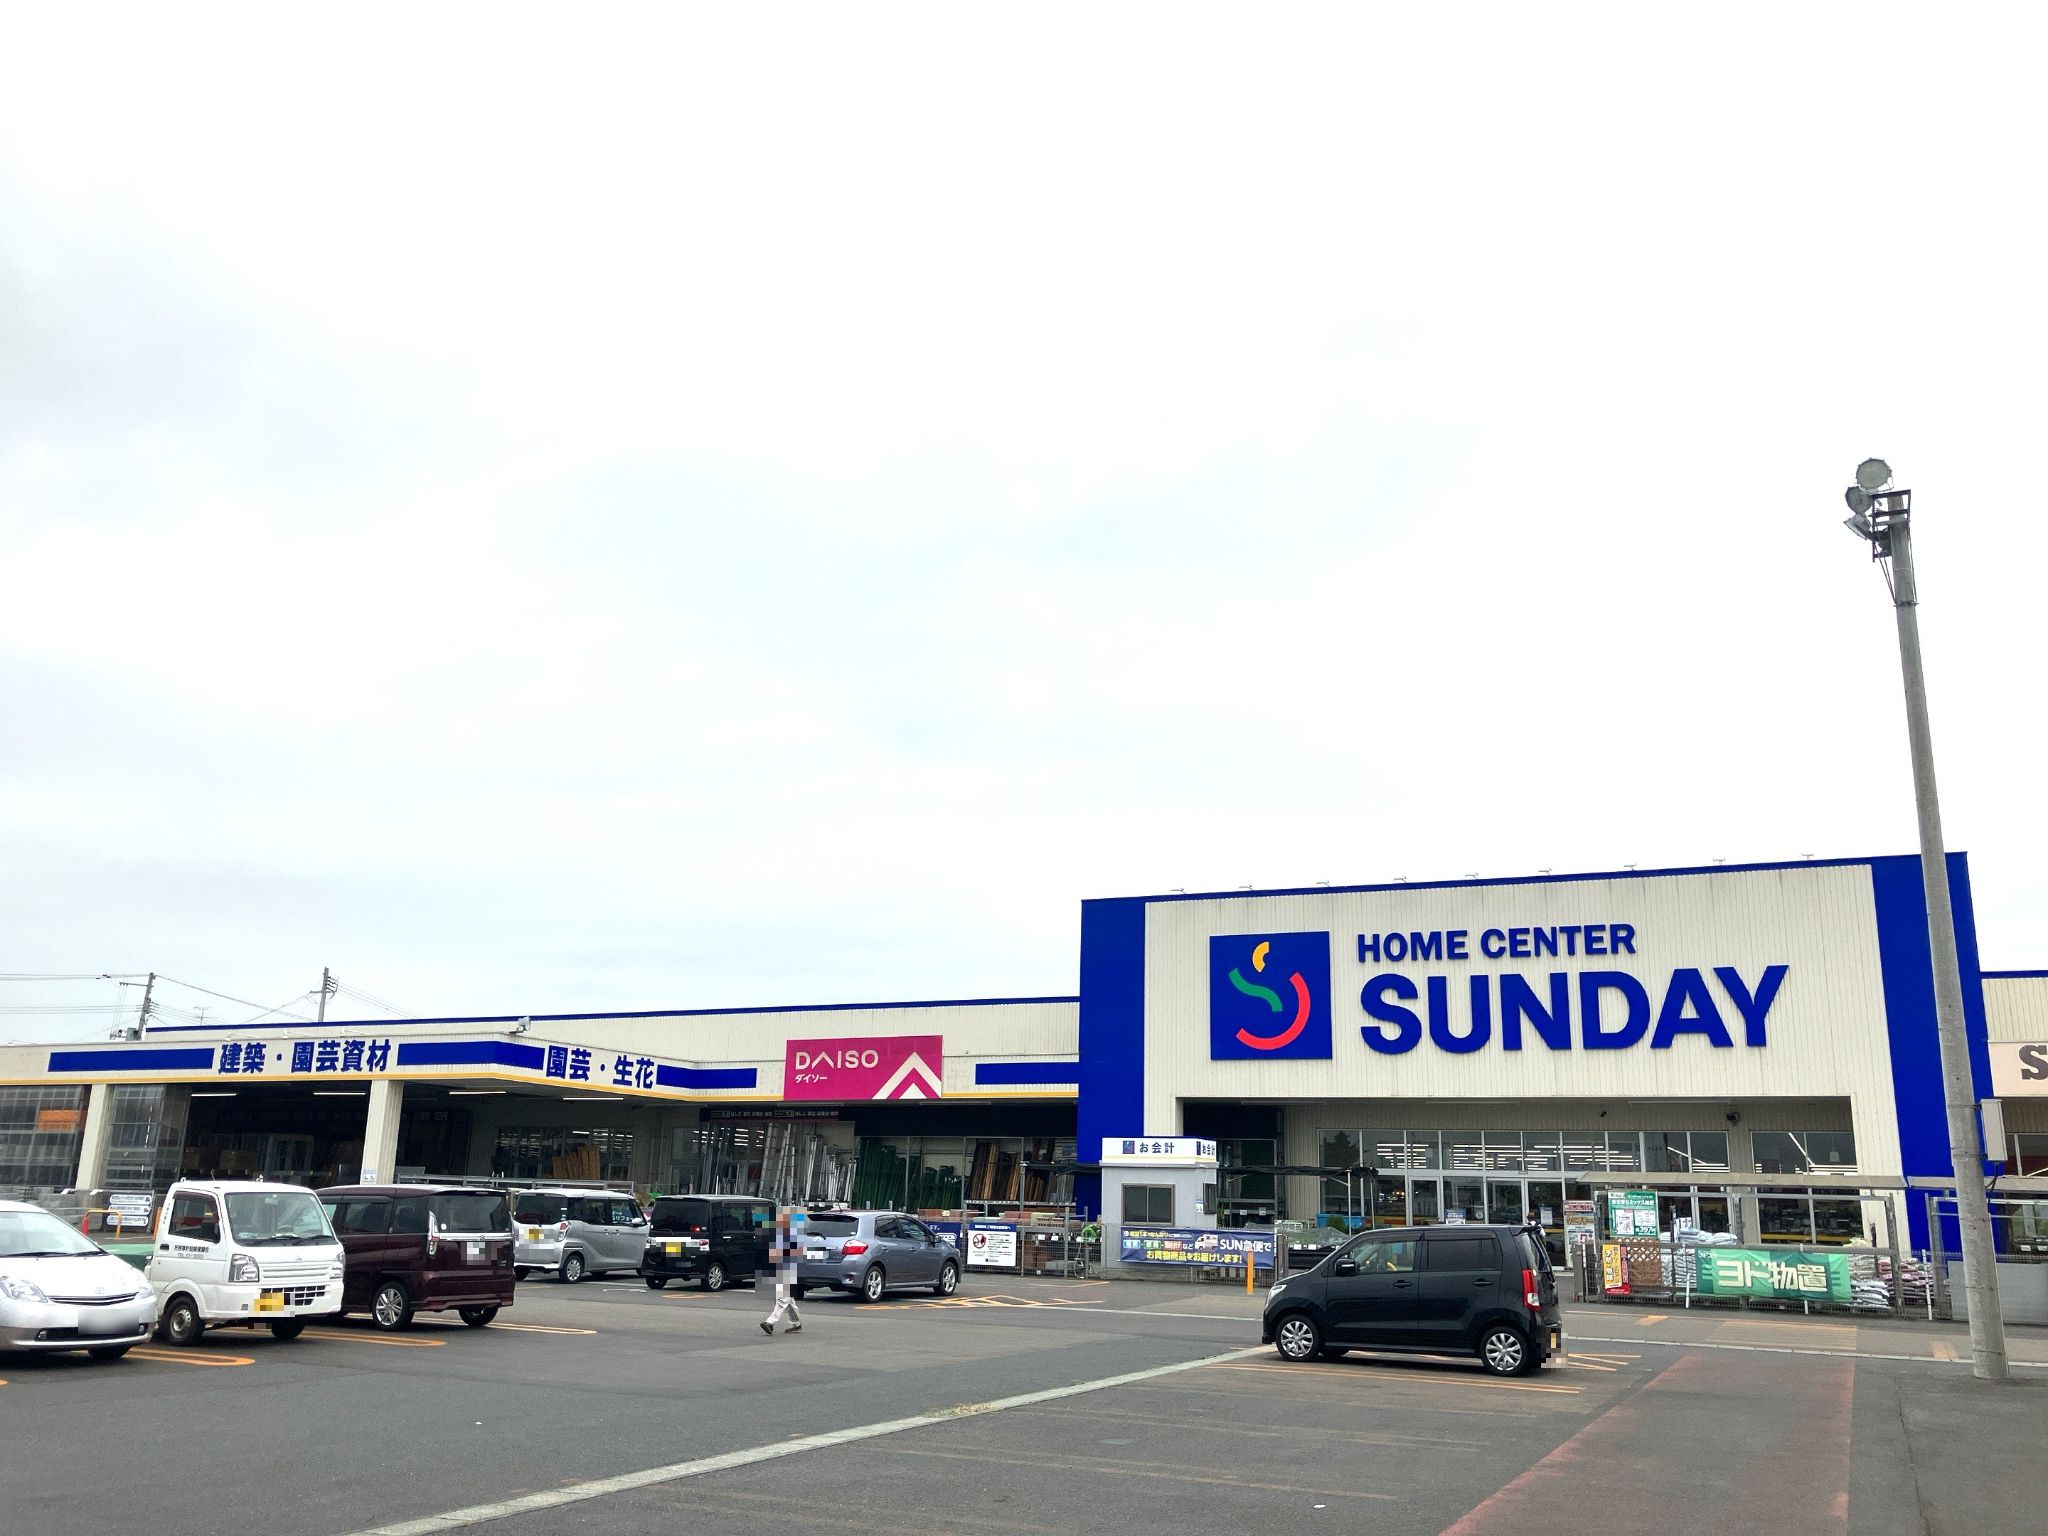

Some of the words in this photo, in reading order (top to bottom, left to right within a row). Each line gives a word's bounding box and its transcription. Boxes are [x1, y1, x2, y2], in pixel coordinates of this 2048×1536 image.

[1357, 930, 1469, 963] HOME
[1480, 923, 1637, 959] CENTER
[1360, 964, 1790, 1054] SUNDAY
[218, 1039, 392, 1074] 建築・園芸資材
[545, 1045, 655, 1089] 園芸・生花
[795, 1049, 879, 1070] DAISO
[794, 1073, 828, 1084] ダイソー
[1139, 1141, 1175, 1154] お会計
[1715, 1260, 1828, 1292] ヨド物置
